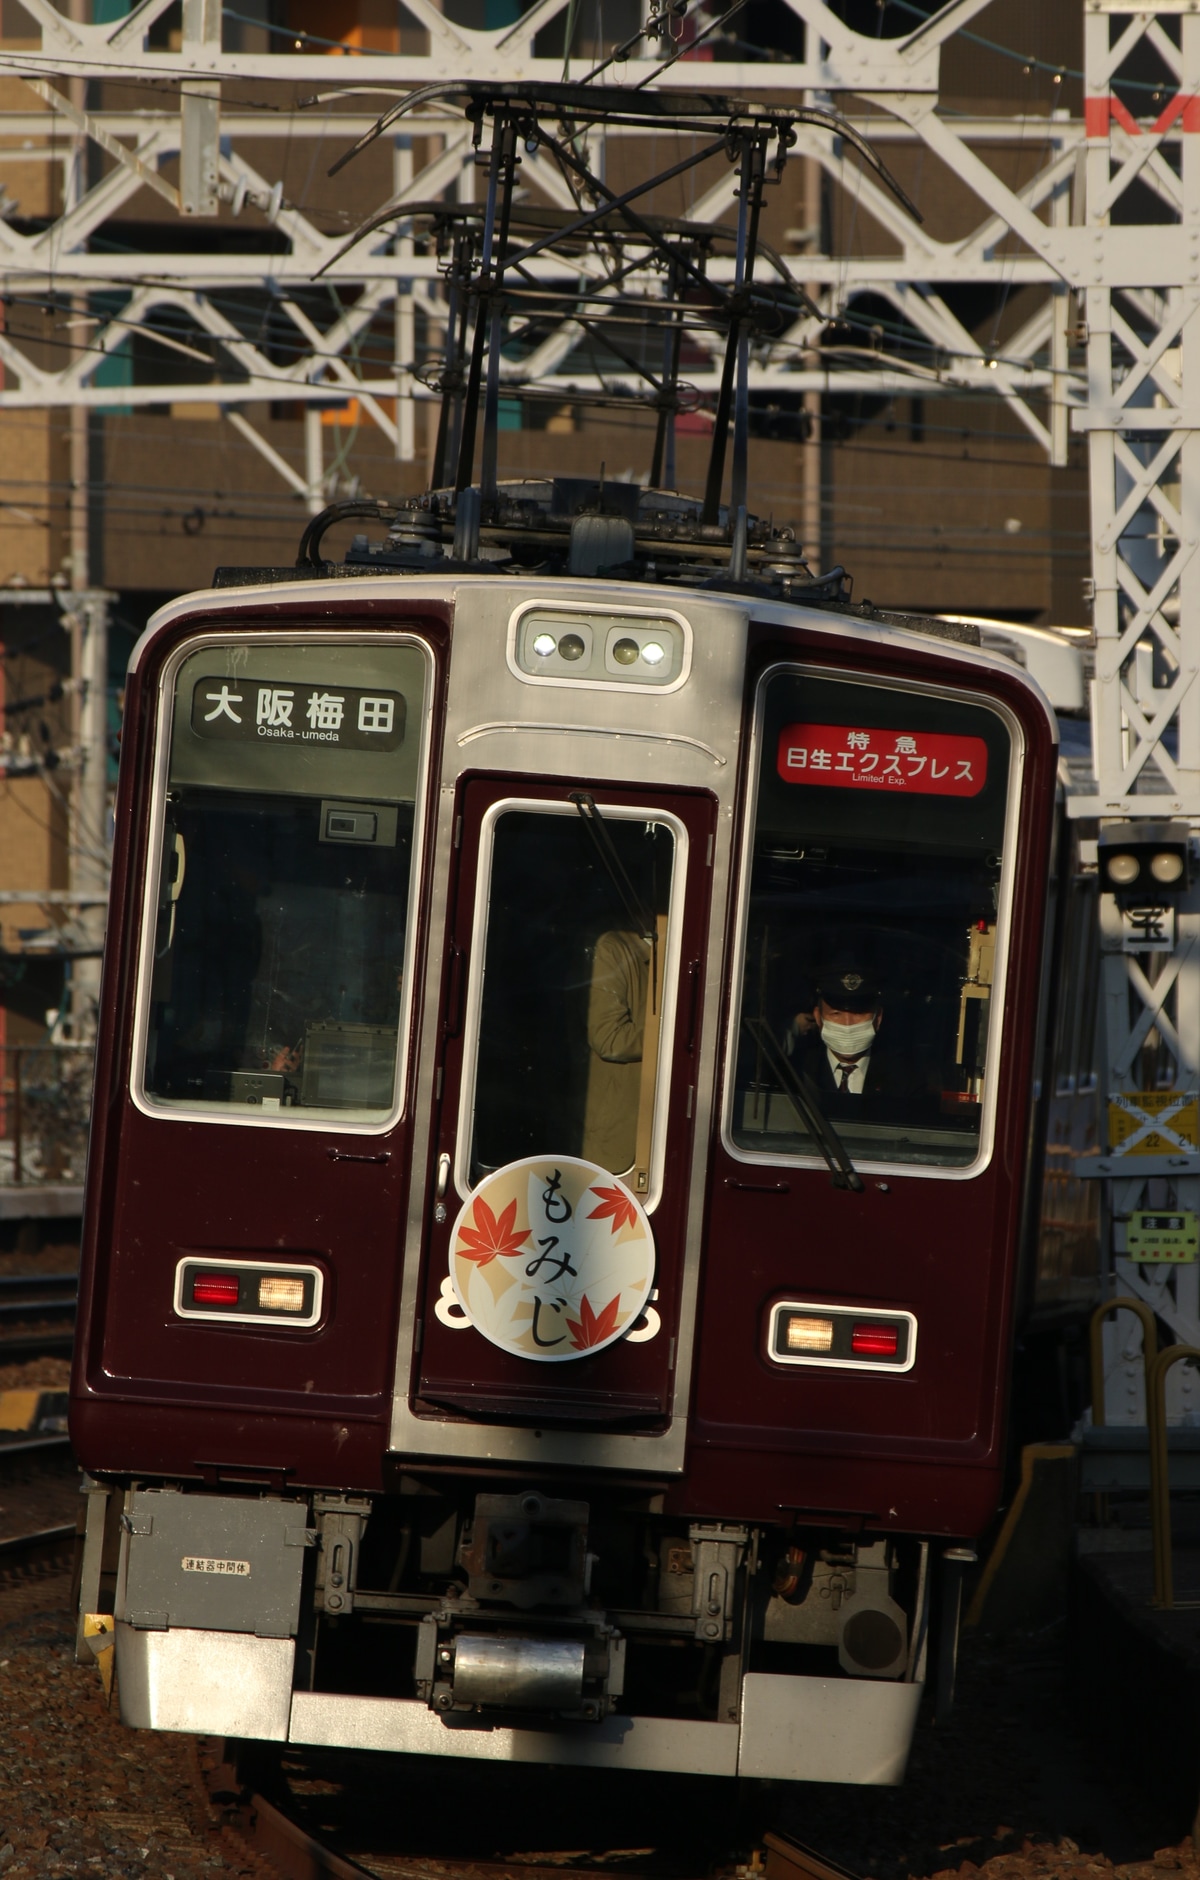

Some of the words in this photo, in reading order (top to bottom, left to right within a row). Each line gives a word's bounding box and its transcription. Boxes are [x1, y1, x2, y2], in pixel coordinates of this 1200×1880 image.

[204, 686, 395, 733] 大阪梅田
[257, 726, 339, 742] Osaka-umeda
[787, 747, 974, 782] 日生エクスプレス
[852, 773, 885, 784] Limited
[888, 775, 907, 786] Exp.
[1146, 1134, 1160, 1147] 22
[1179, 1133, 1192, 1147] 21
[525, 1168, 578, 1348] もみじ
[186, 1559, 246, 1574] 連結器中間体
